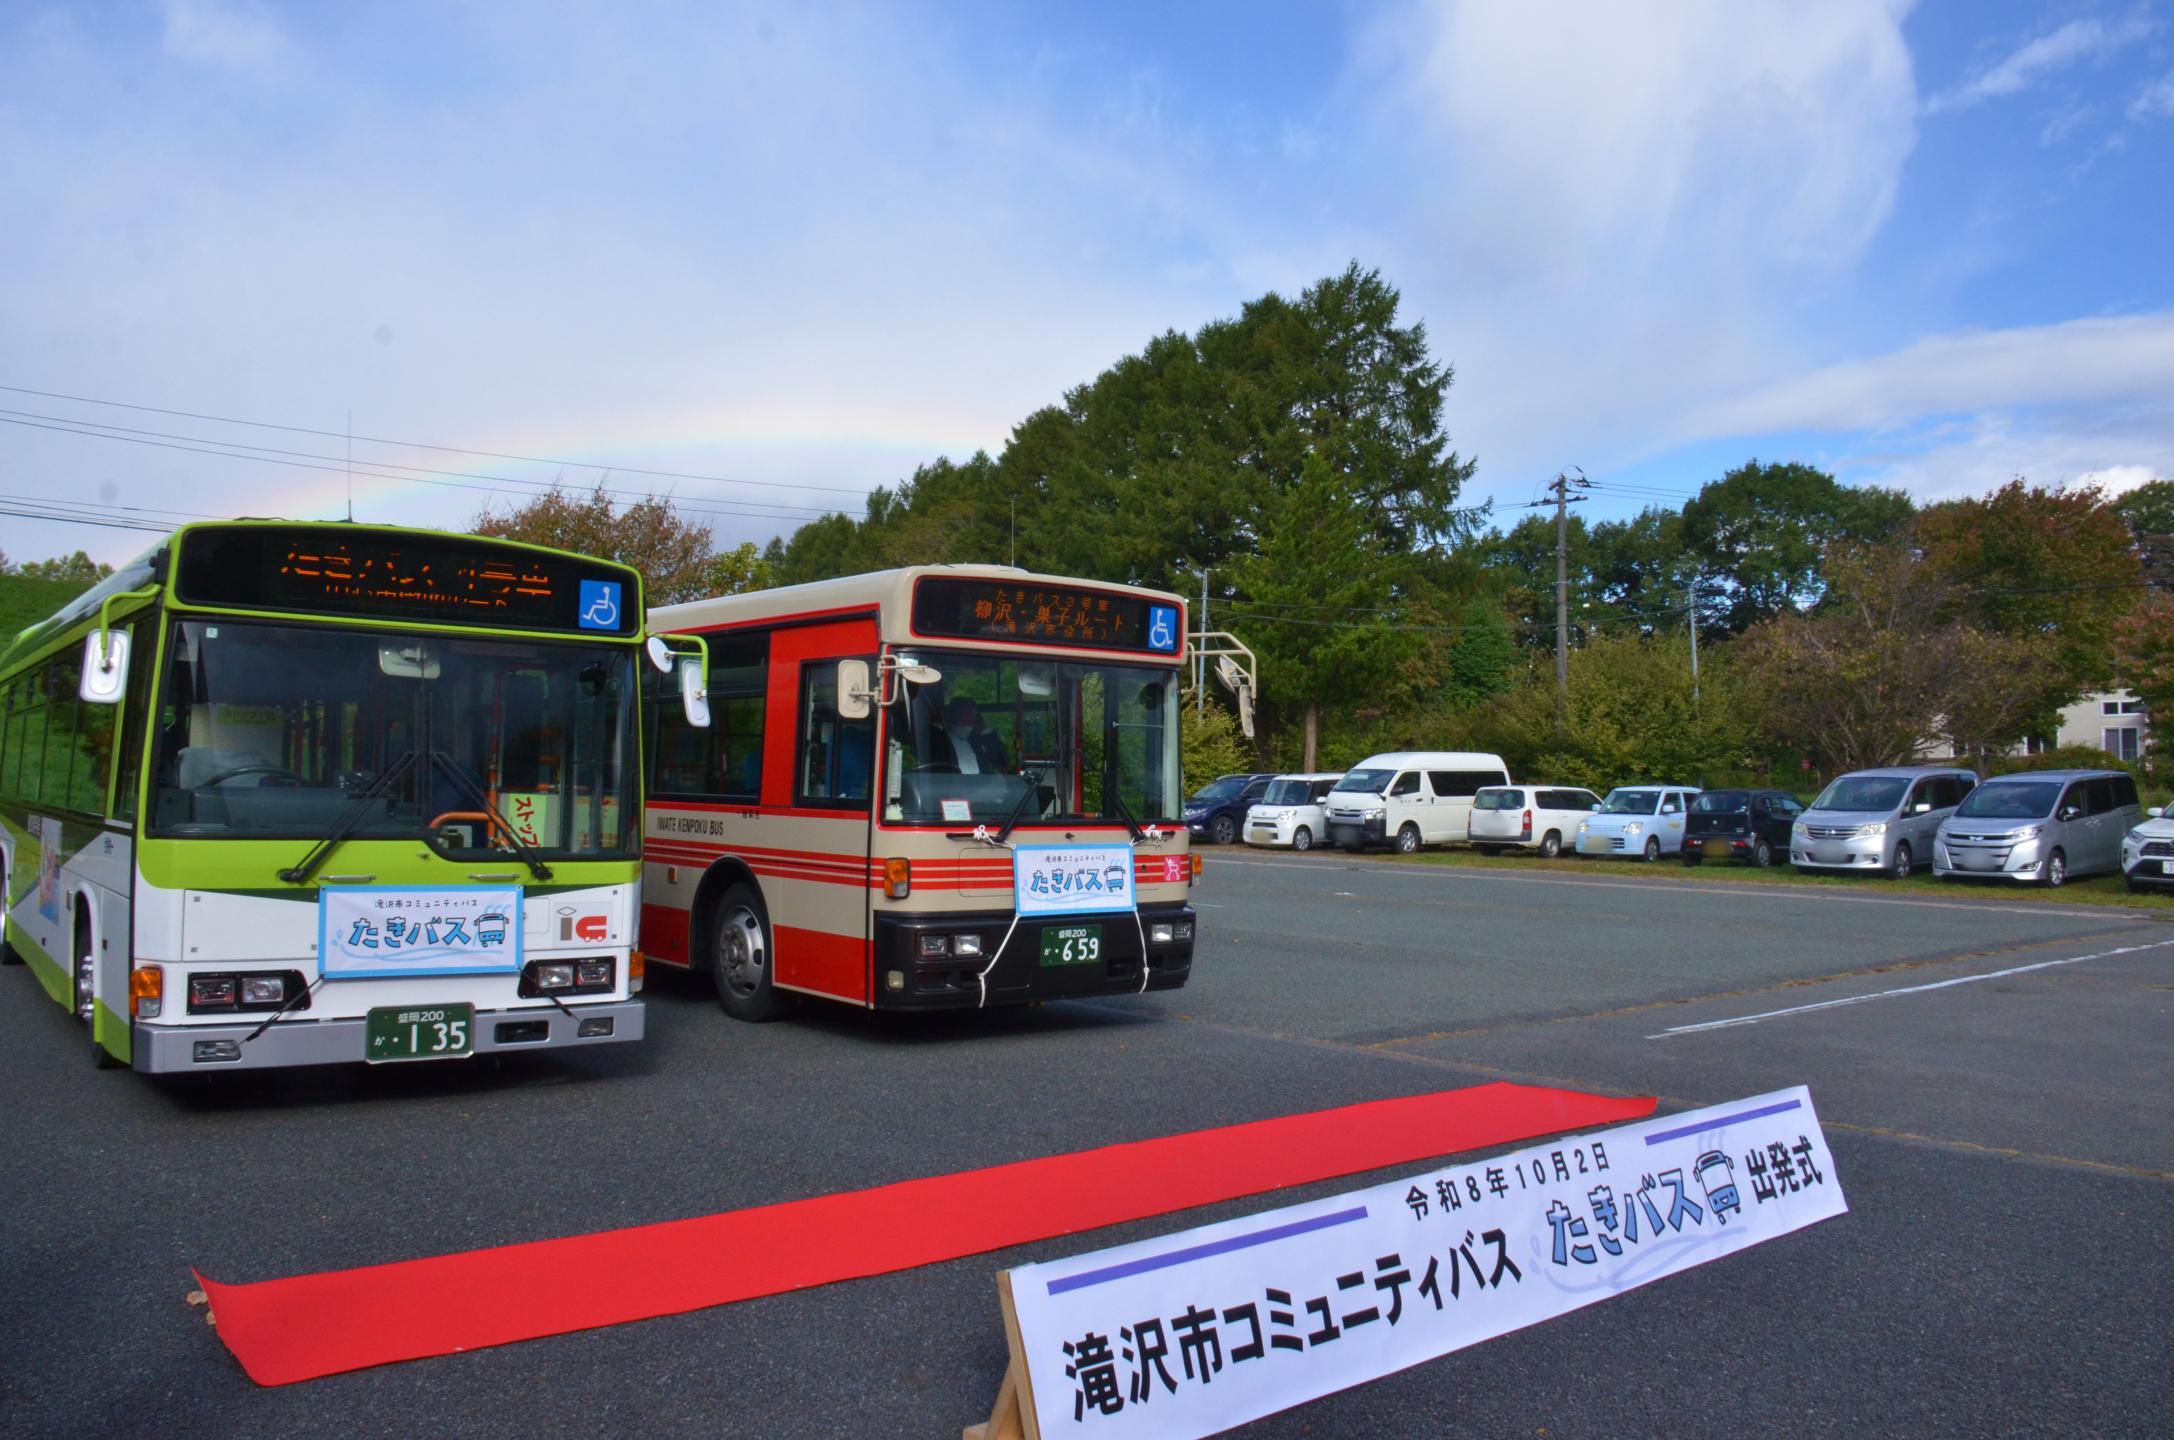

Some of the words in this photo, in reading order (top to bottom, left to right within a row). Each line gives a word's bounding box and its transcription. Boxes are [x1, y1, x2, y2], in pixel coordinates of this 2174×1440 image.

[656, 816, 676, 832] IWATE
[677, 818, 708, 834] KENPOKU
[709, 820, 724, 835] BUS
[1031, 868, 1103, 893] たきバス
[348, 916, 471, 948] たきバス
[1405, 1142, 1610, 1221] 令和8年10月2日
[1062, 1228, 1522, 1423] 滝沢市コミュニティバス
[1545, 1172, 1704, 1266] たきバス
[1744, 1135, 1823, 1204] 出発式
